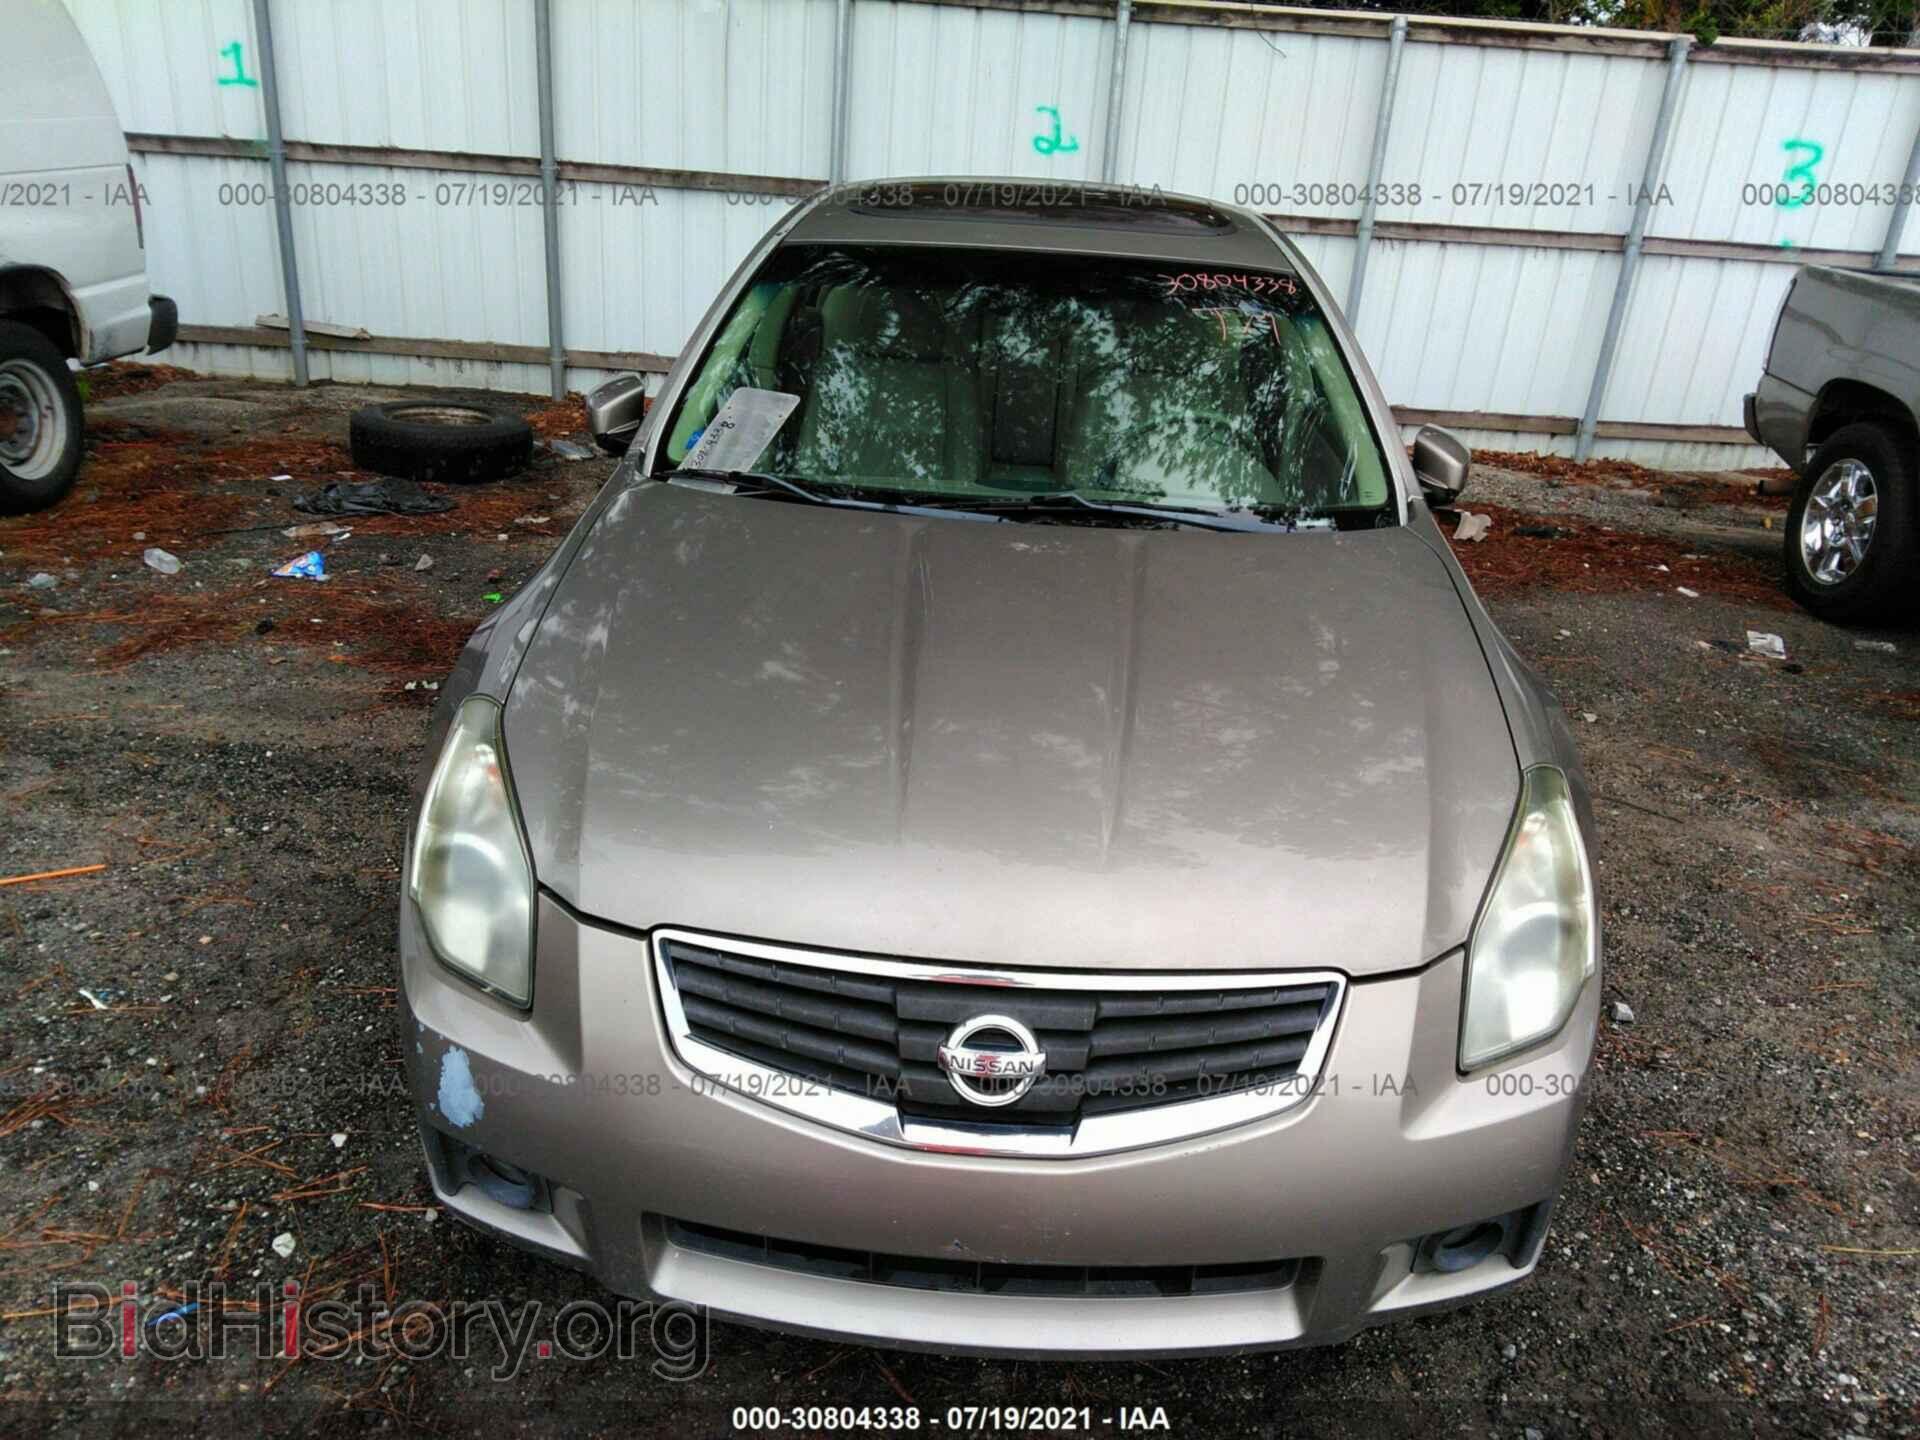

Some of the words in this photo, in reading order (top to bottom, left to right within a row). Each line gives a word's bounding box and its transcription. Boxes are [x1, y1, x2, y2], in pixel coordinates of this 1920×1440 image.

[217, 42, 259, 87] 1
[1032, 106, 1079, 155] 2
[1777, 138, 1824, 210] 3
[950, 1055, 1034, 1073] NISSAN
